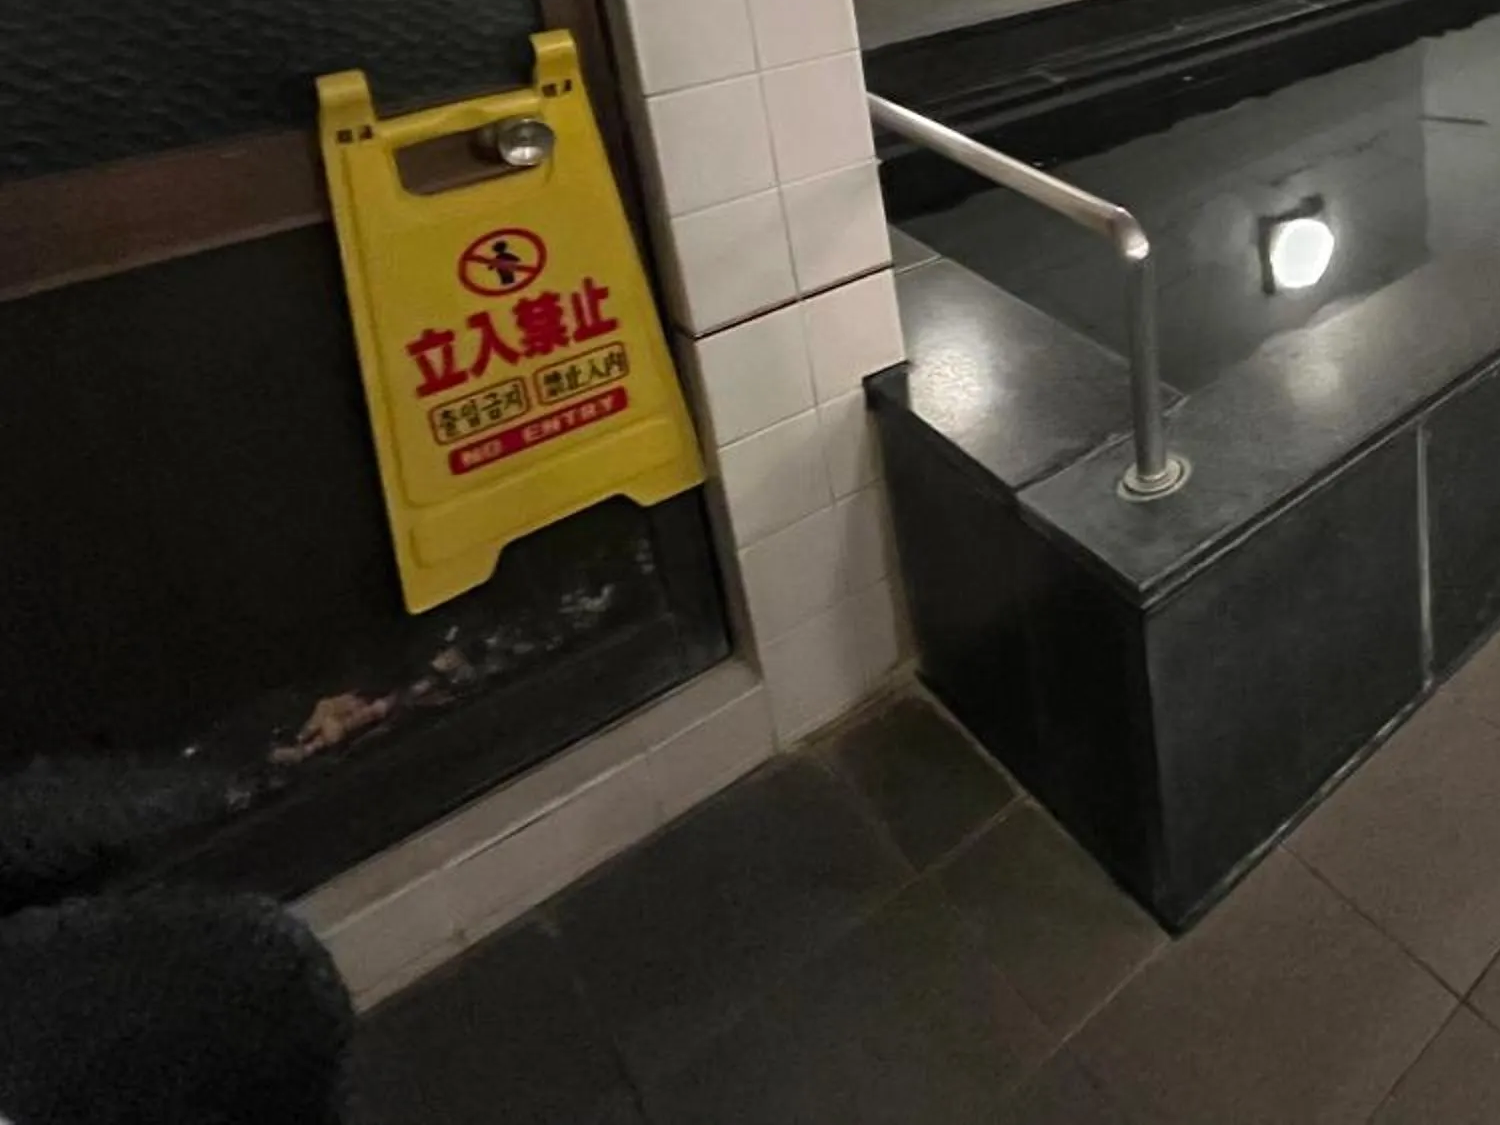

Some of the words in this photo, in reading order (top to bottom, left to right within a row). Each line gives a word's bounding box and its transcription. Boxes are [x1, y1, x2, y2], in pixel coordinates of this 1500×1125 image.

[406, 276, 619, 398] 立入禁止
[461, 440, 501, 468] NO
[522, 395, 615, 443] ENTRY
